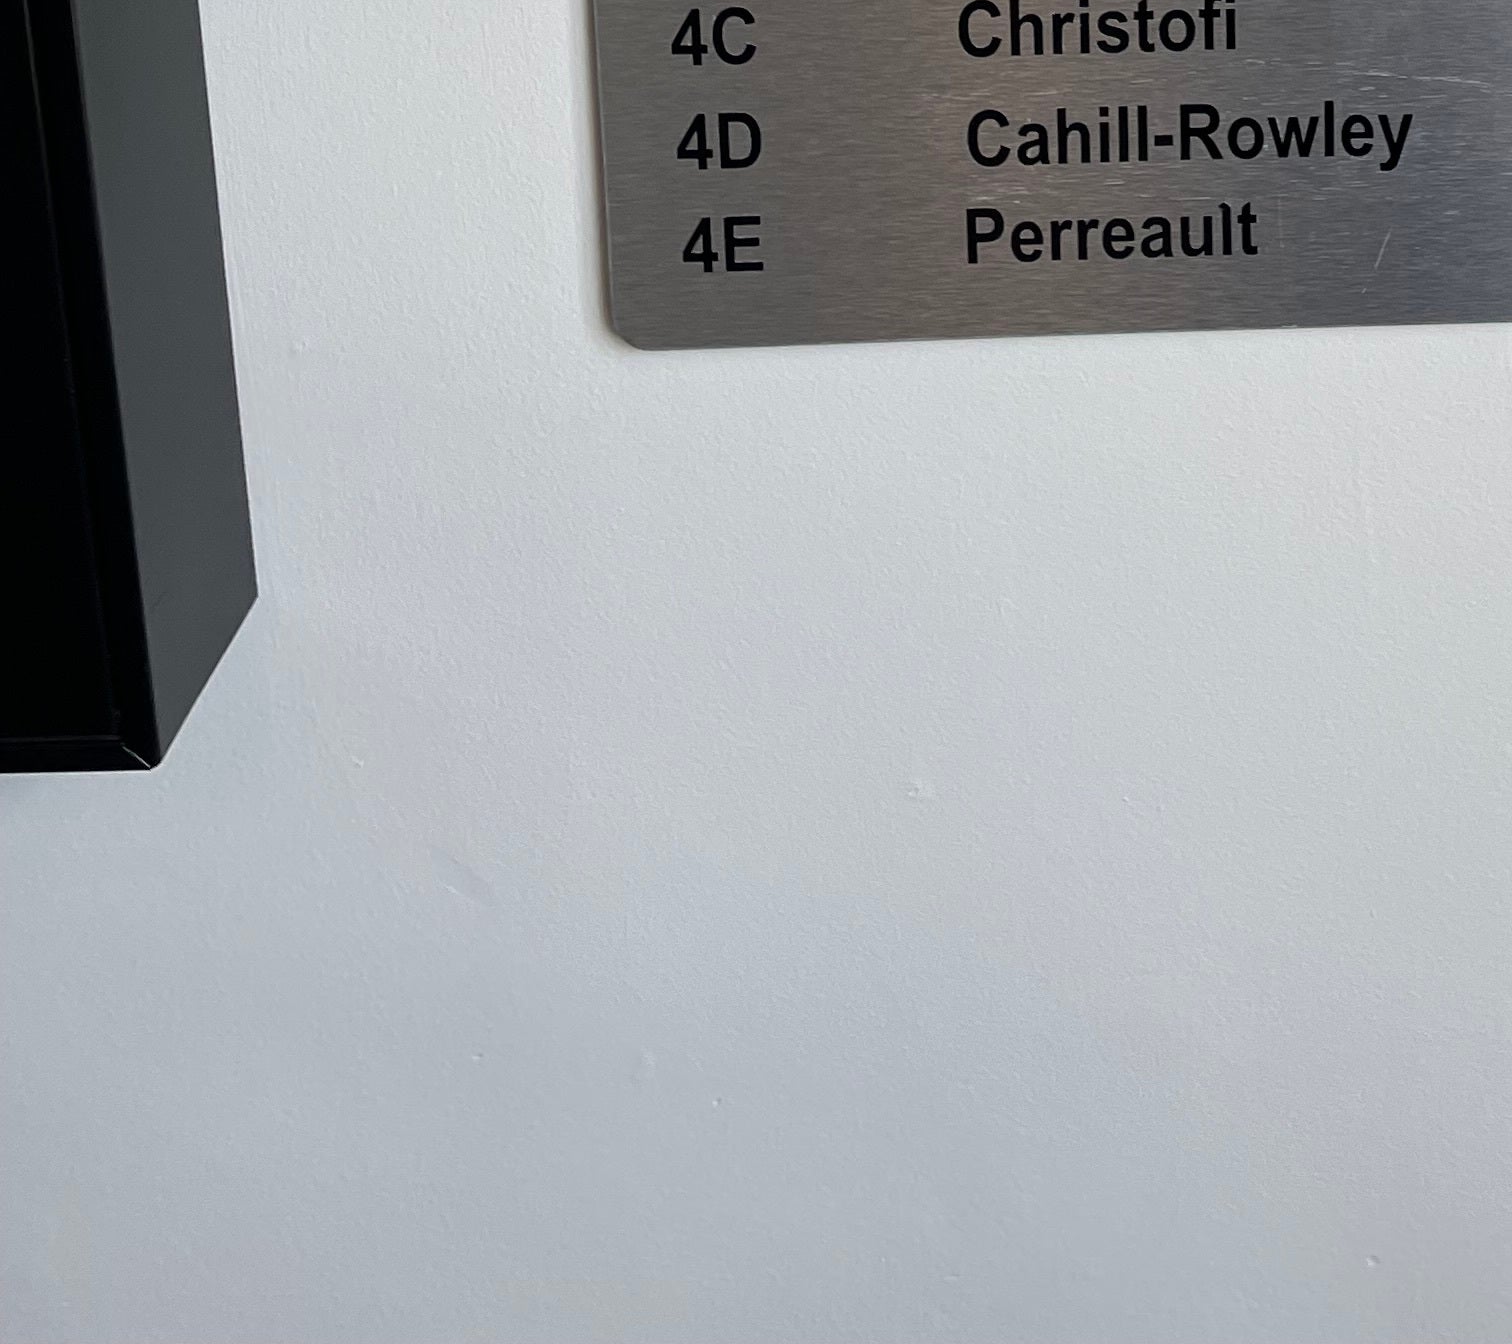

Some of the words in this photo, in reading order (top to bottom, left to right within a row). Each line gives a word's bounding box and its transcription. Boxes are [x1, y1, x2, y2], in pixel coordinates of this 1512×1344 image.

[670, 6, 757, 66] 4C
[676, 112, 762, 171] 4D
[967, 100, 1414, 172] Cahill-Rowley
[682, 215, 764, 273] 4E
[965, 201, 1259, 265] Perreault
